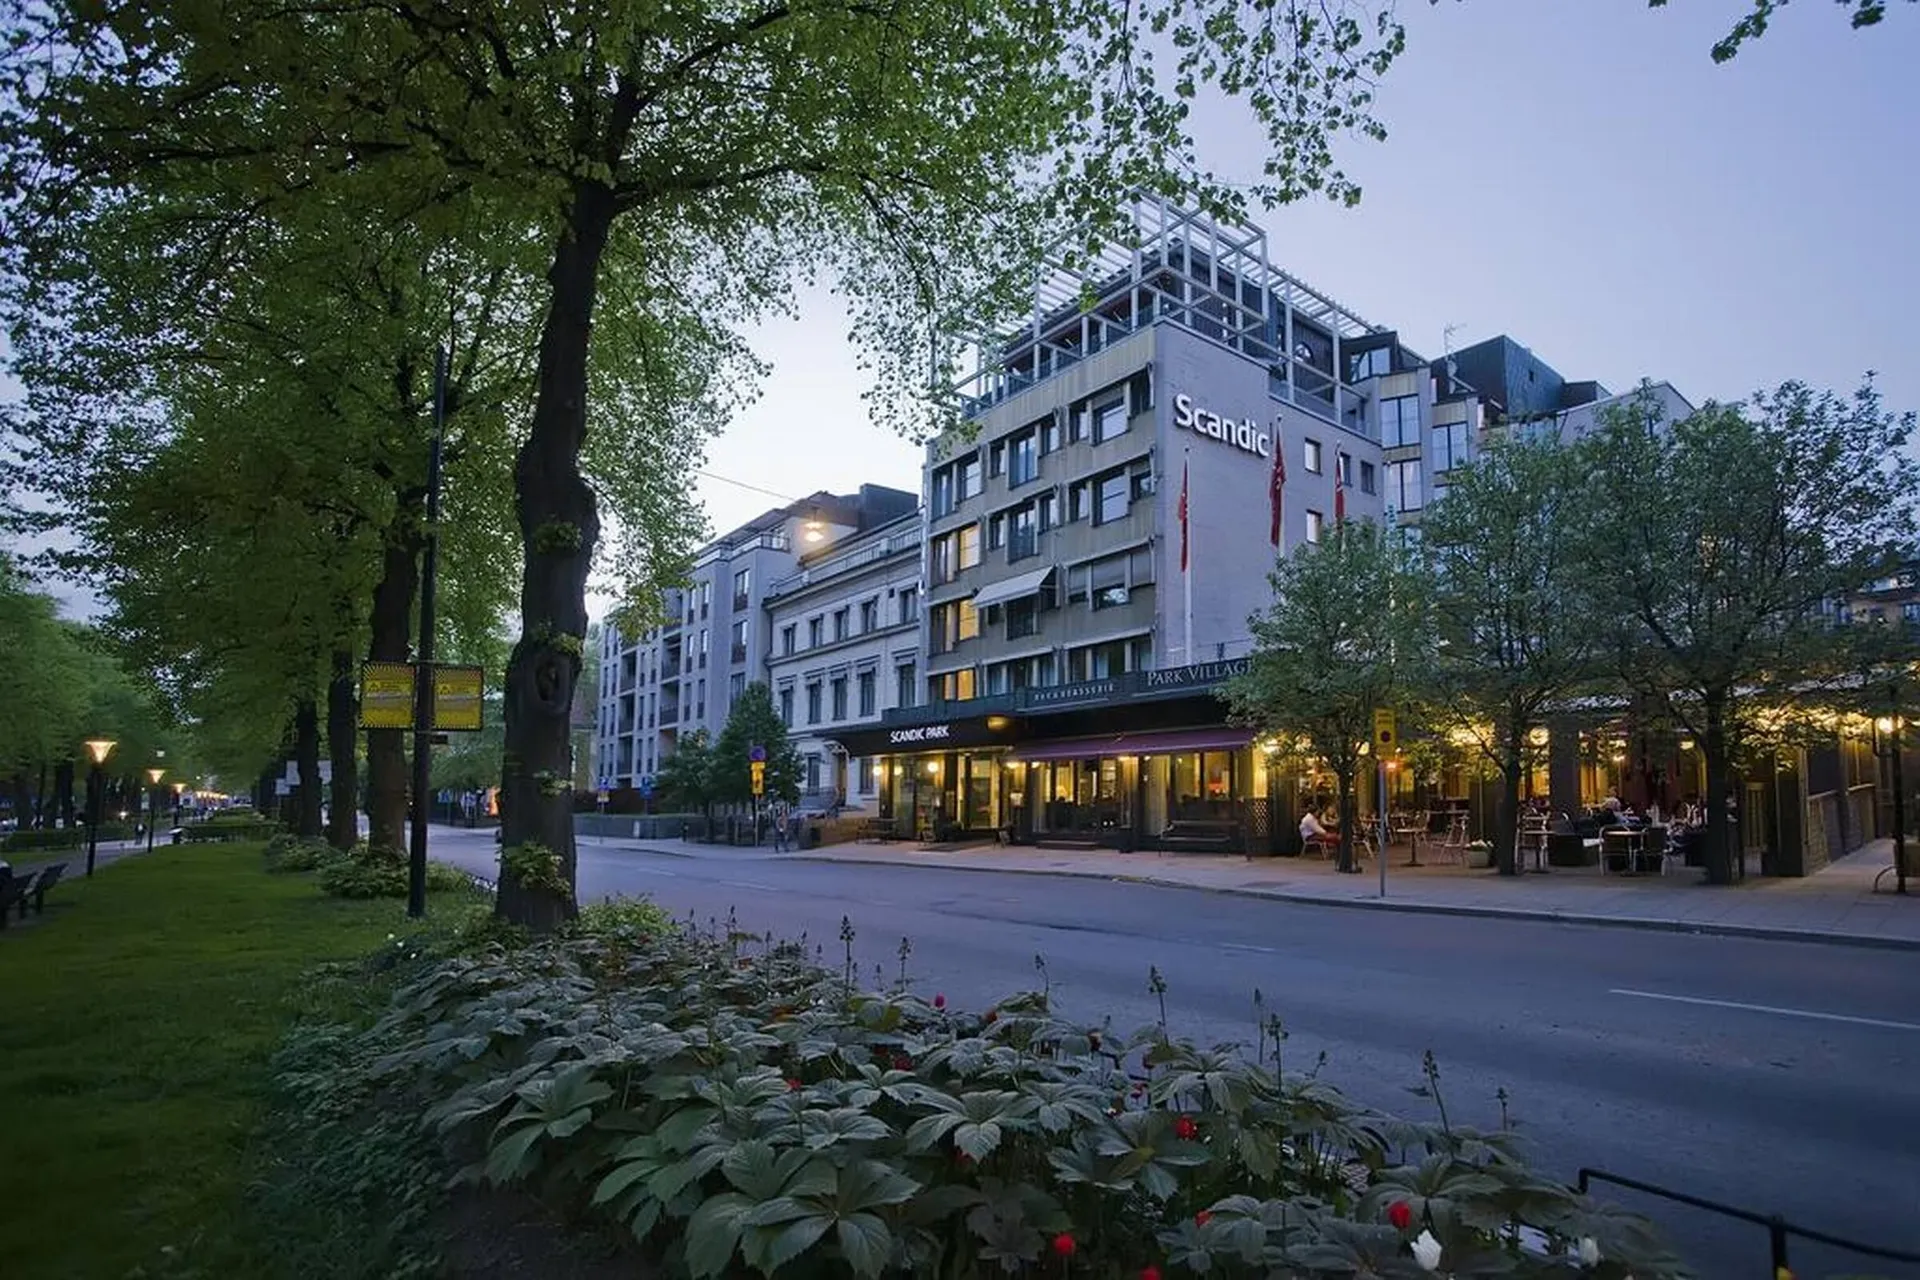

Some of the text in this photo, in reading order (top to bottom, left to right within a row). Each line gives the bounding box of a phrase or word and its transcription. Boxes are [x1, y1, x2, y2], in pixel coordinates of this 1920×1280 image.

[1175, 392, 1270, 457] Scandic
[1147, 669, 1184, 687] PARK
[890, 724, 949, 743] SCANDIC PARK
